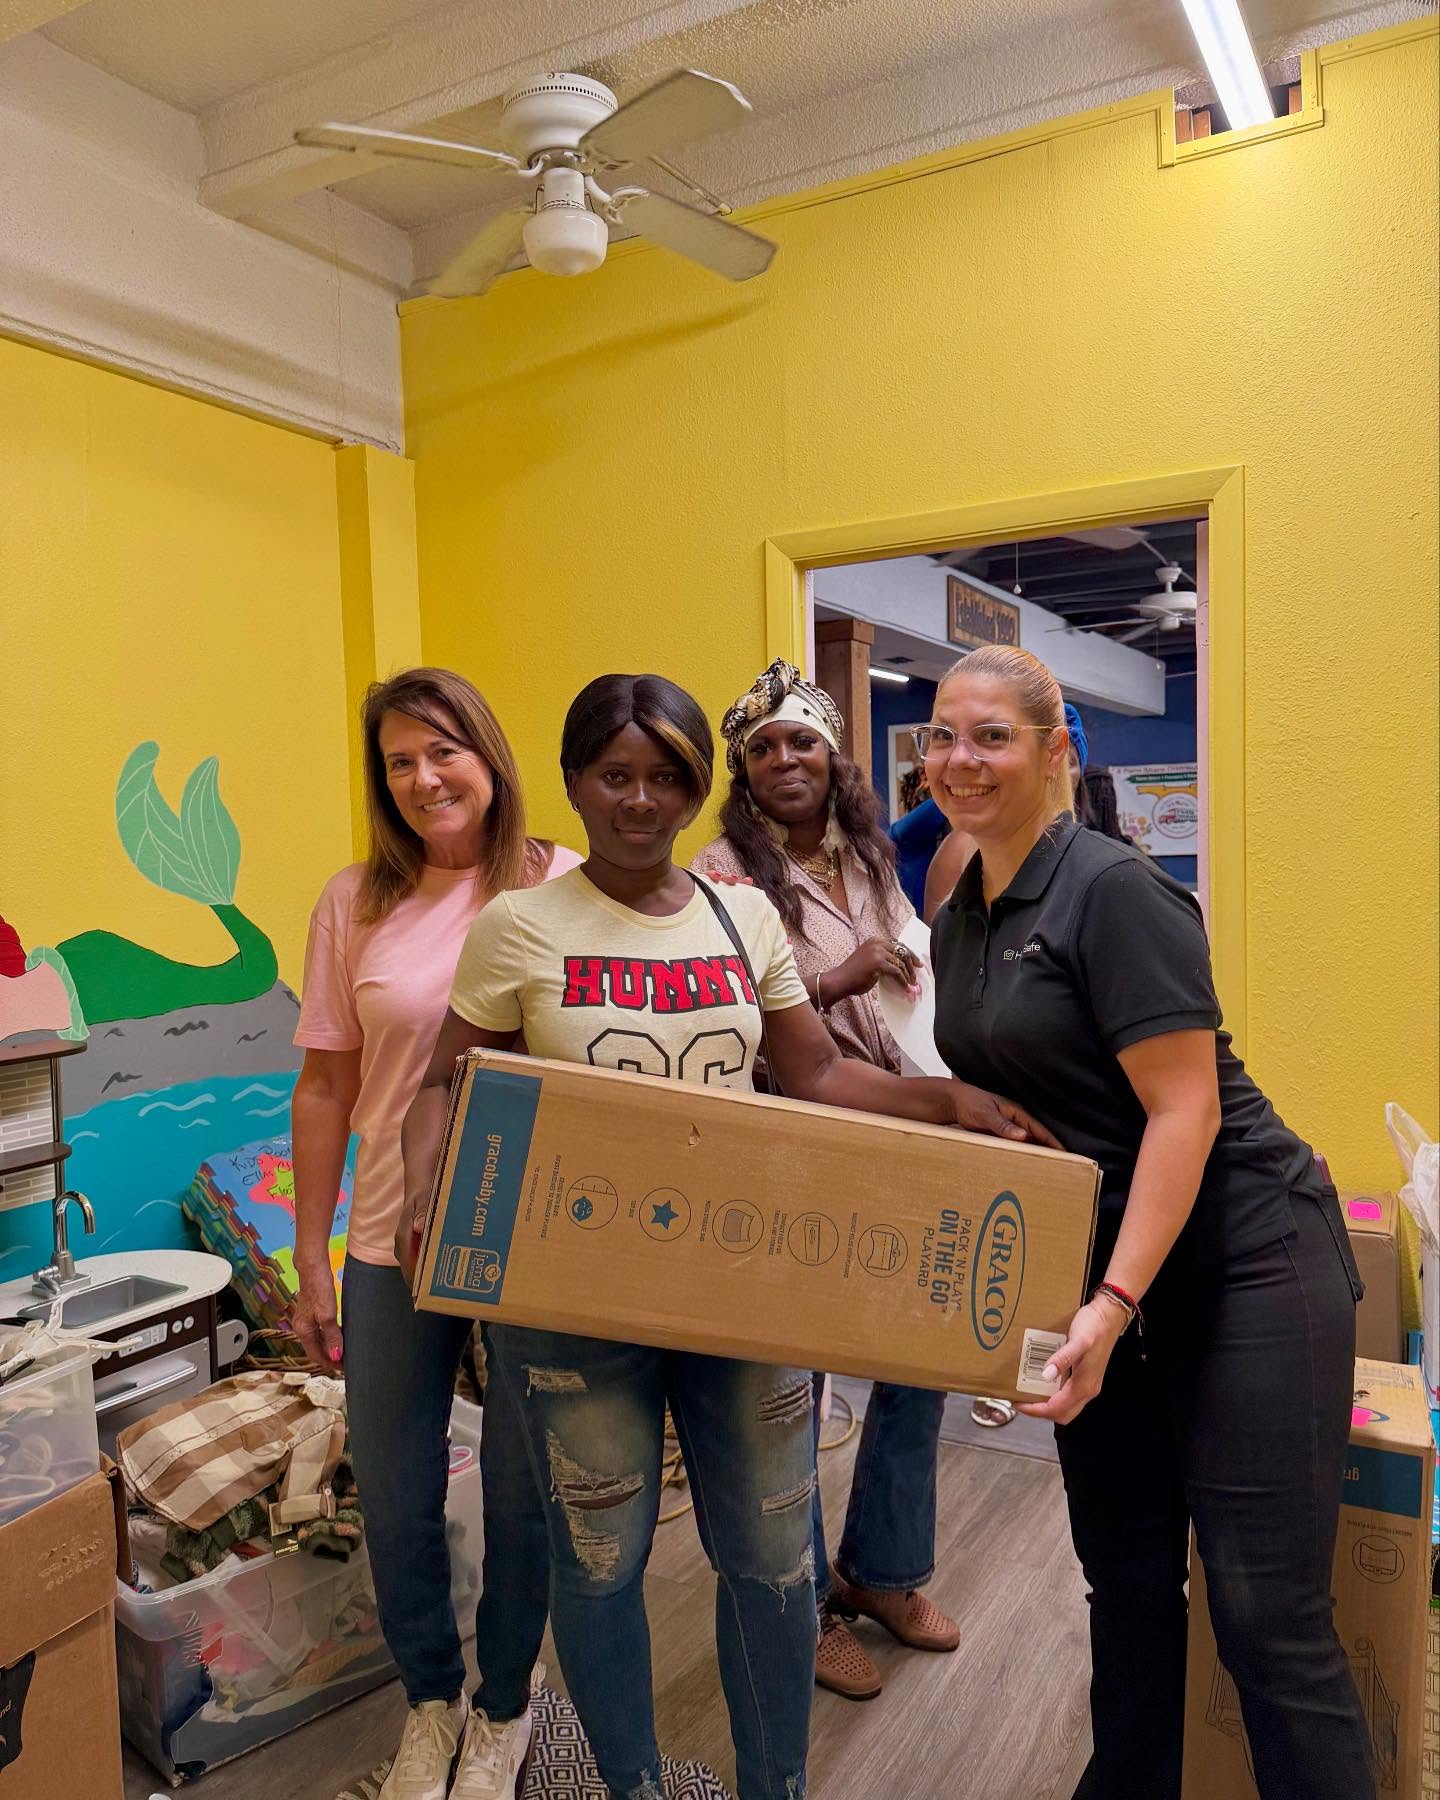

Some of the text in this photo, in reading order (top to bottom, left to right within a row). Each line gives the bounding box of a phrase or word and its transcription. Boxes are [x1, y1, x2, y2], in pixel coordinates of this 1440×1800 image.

[472, 1134, 502, 1237] gracobaby.com
[940, 1209, 960, 1236] ON
[959, 1218, 972, 1253] PACK
[918, 1227, 935, 1288] PLAYARD
[934, 1240, 957, 1276] THE
